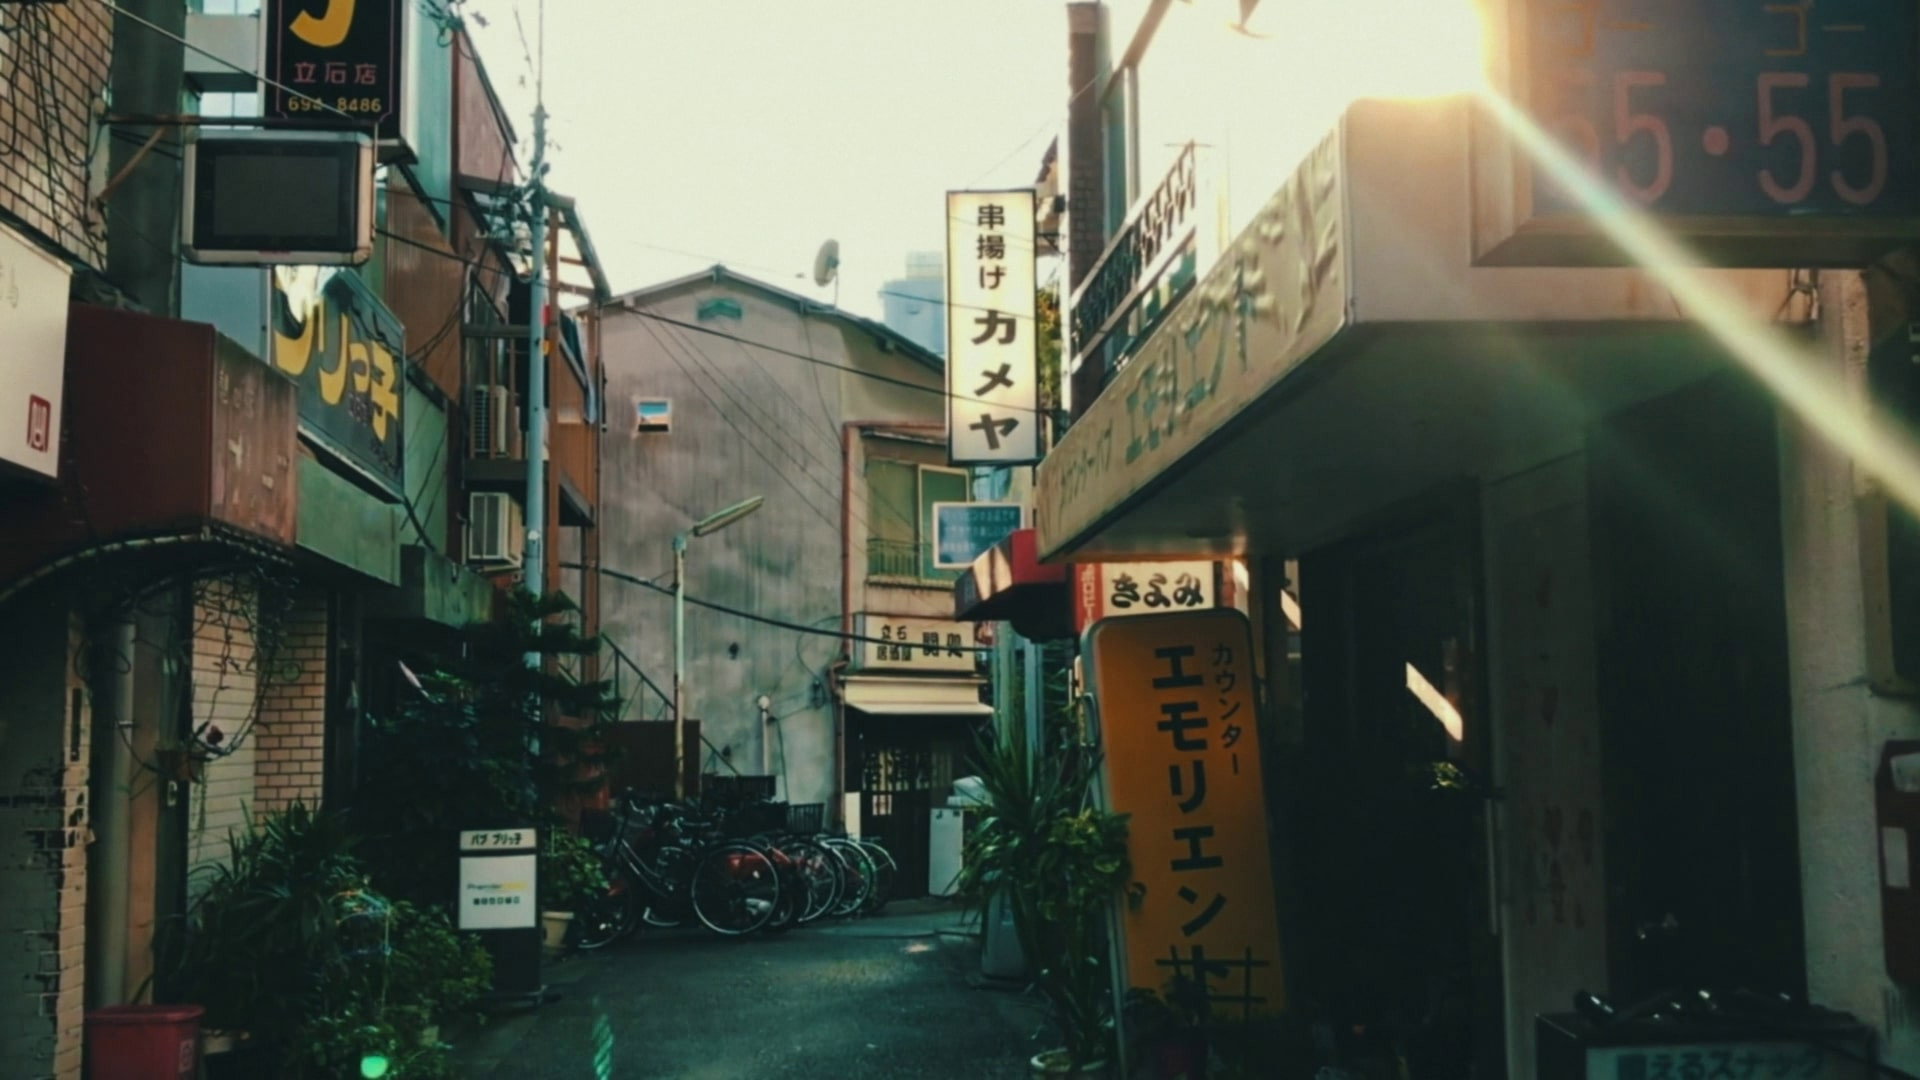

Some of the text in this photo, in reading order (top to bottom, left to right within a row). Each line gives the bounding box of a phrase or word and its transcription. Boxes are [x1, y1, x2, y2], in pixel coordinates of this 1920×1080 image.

[292, 60, 378, 86] 立石店
[336, 96, 383, 113] 8486
[968, 202, 1019, 450] 串揚げ カメヤ
[1110, 571, 1205, 609] きよみ
[1210, 640, 1244, 777] カウンター
